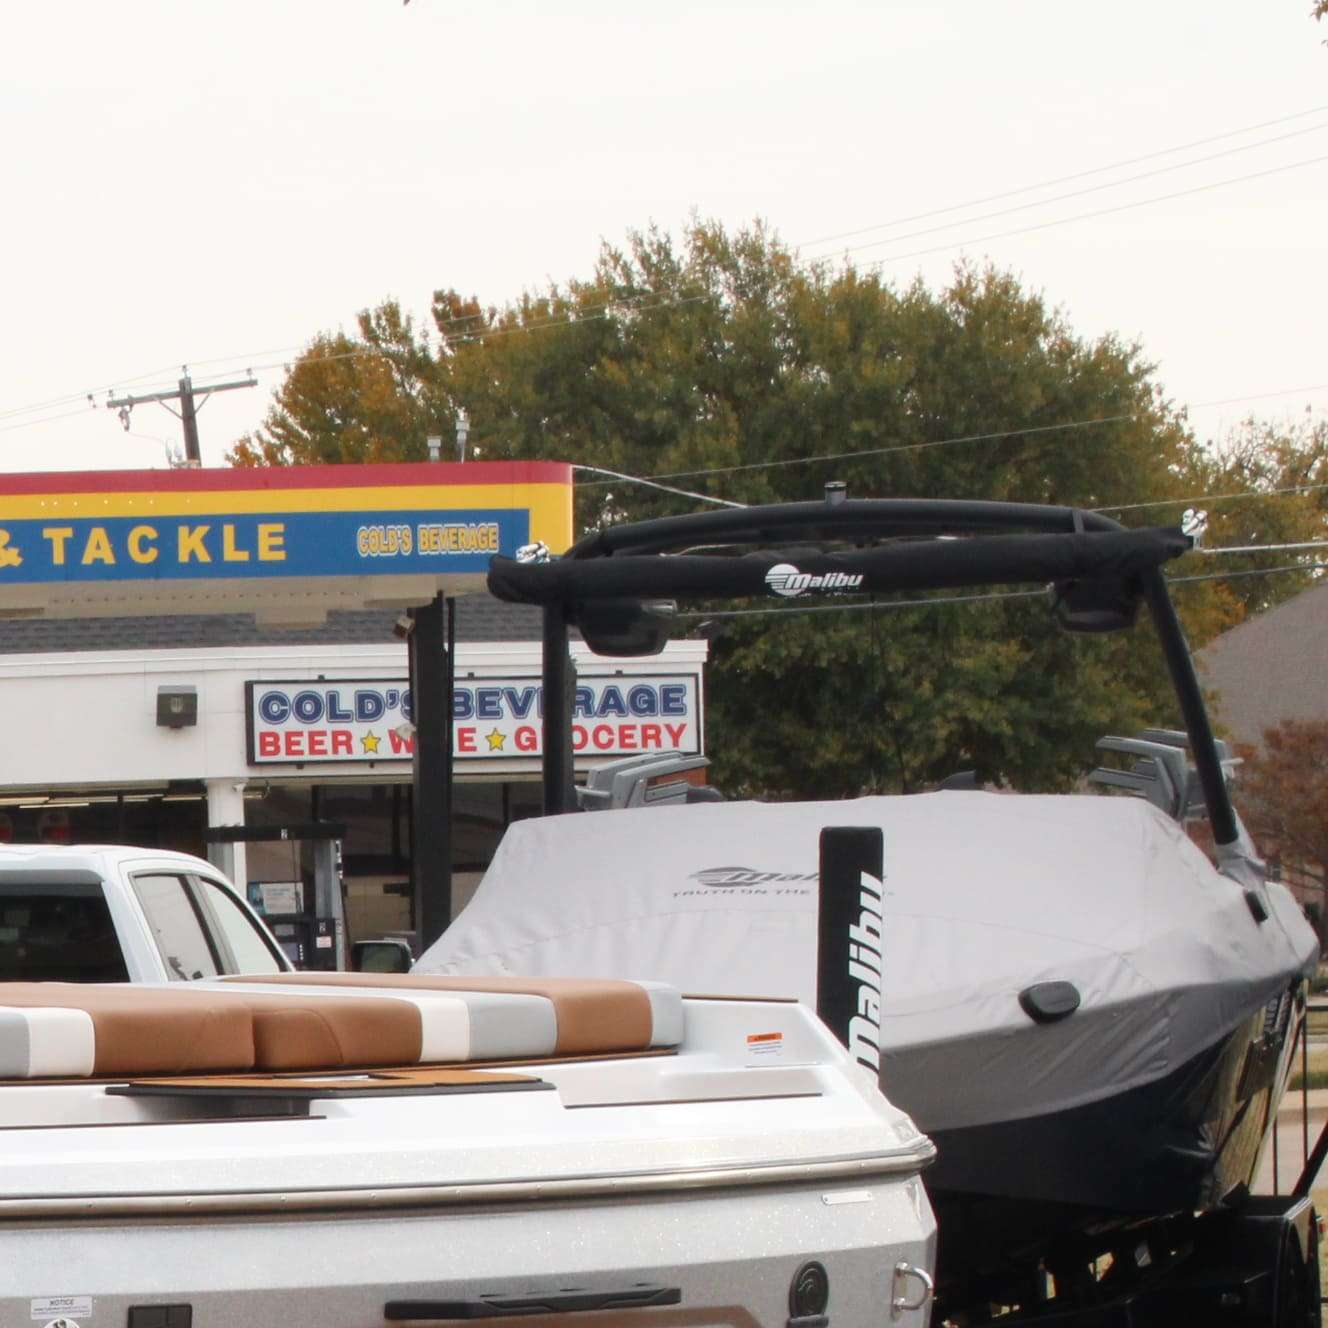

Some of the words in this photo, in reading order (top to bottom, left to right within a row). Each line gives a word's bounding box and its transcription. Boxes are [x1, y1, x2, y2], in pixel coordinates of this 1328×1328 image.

[43, 523, 287, 565] TACKLE
[356, 524, 413, 557] COLD'S
[418, 521, 500, 554] BEVERAGE
[451, 683, 689, 721] BEVRAGE
[258, 729, 355, 757] BEER
[387, 727, 478, 755] WE
[513, 722, 688, 753] GOCERY
